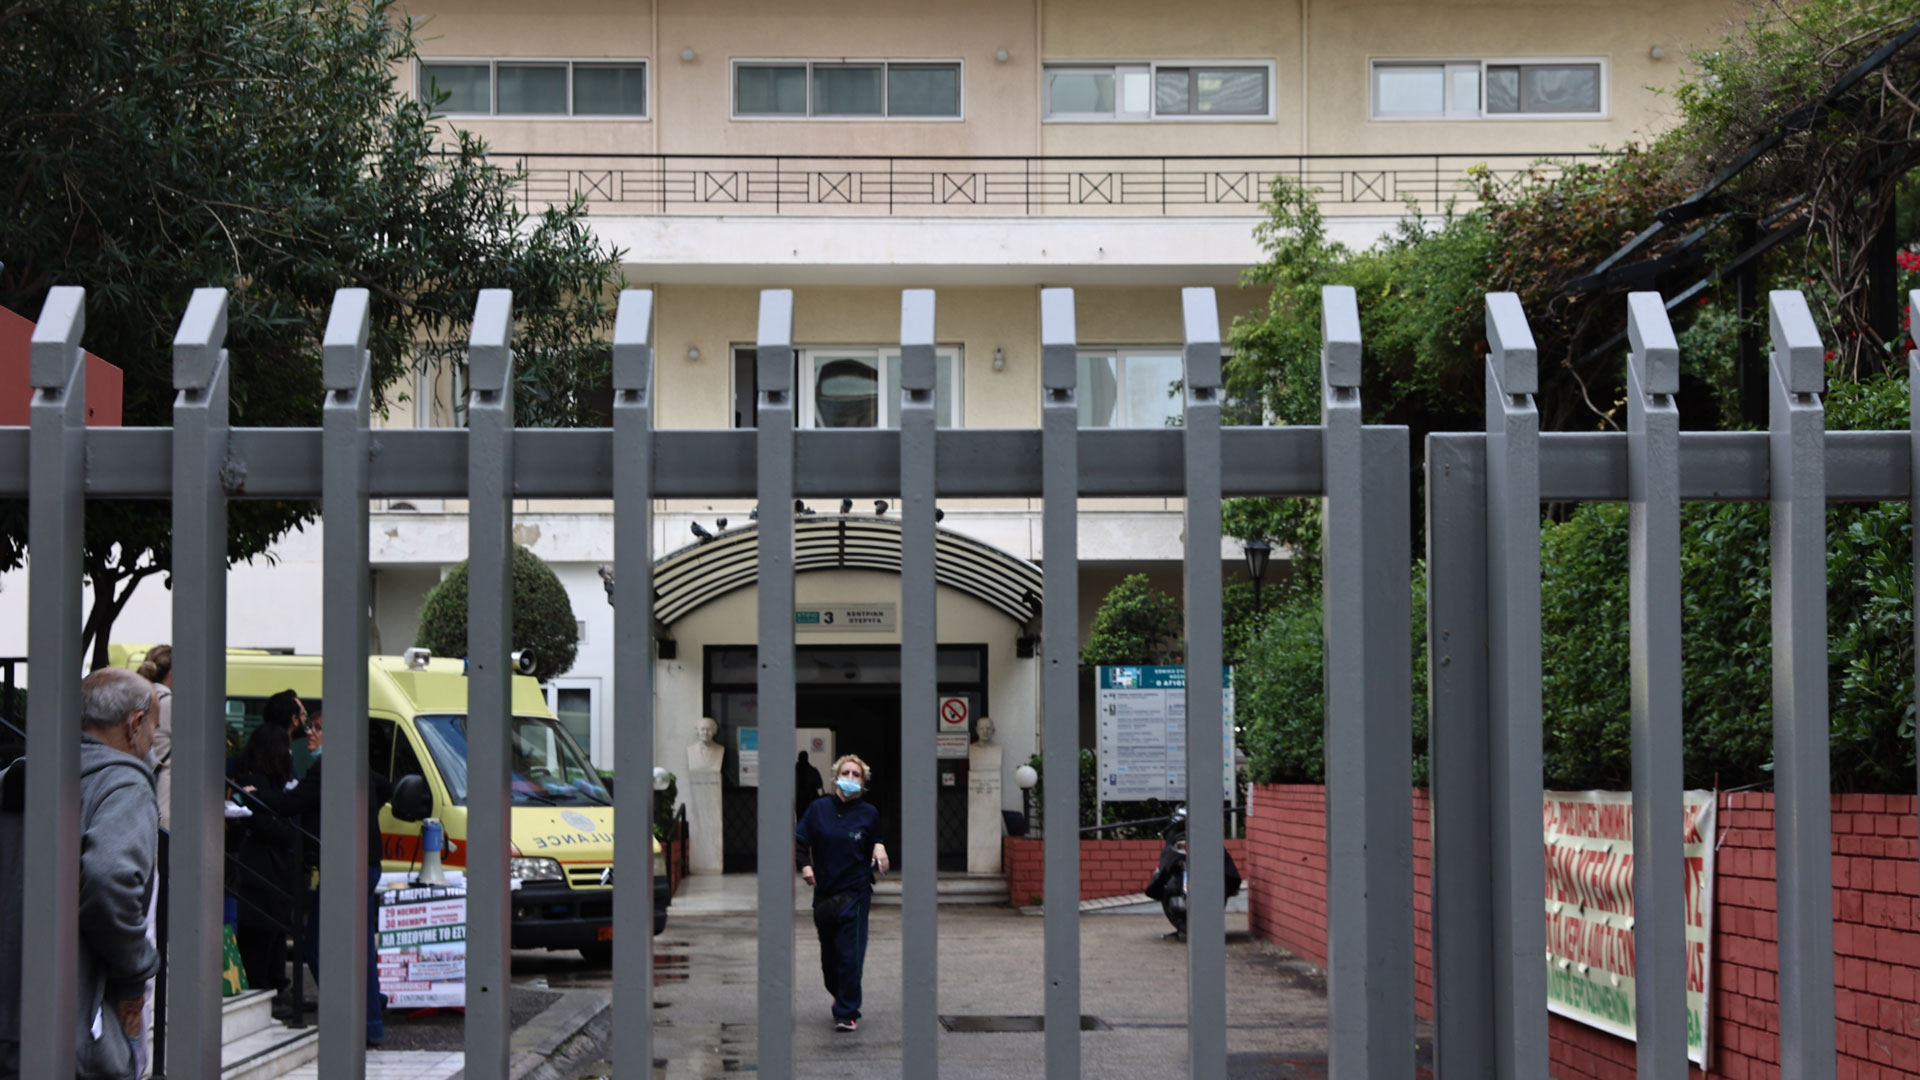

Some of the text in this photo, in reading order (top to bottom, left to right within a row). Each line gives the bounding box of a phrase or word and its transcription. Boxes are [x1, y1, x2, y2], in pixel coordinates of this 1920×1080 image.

[823, 611, 834, 624] 3
[399, 887, 431, 901] ΑΠΕΡΓΙΑ
[385, 908, 395, 918] 29
[385, 919, 396, 929] 30
[382, 933, 395, 947] ΝΑ
[396, 928, 438, 945] ΣΩΣΟΥΜΕ
[438, 927, 451, 941] ΤΟ
